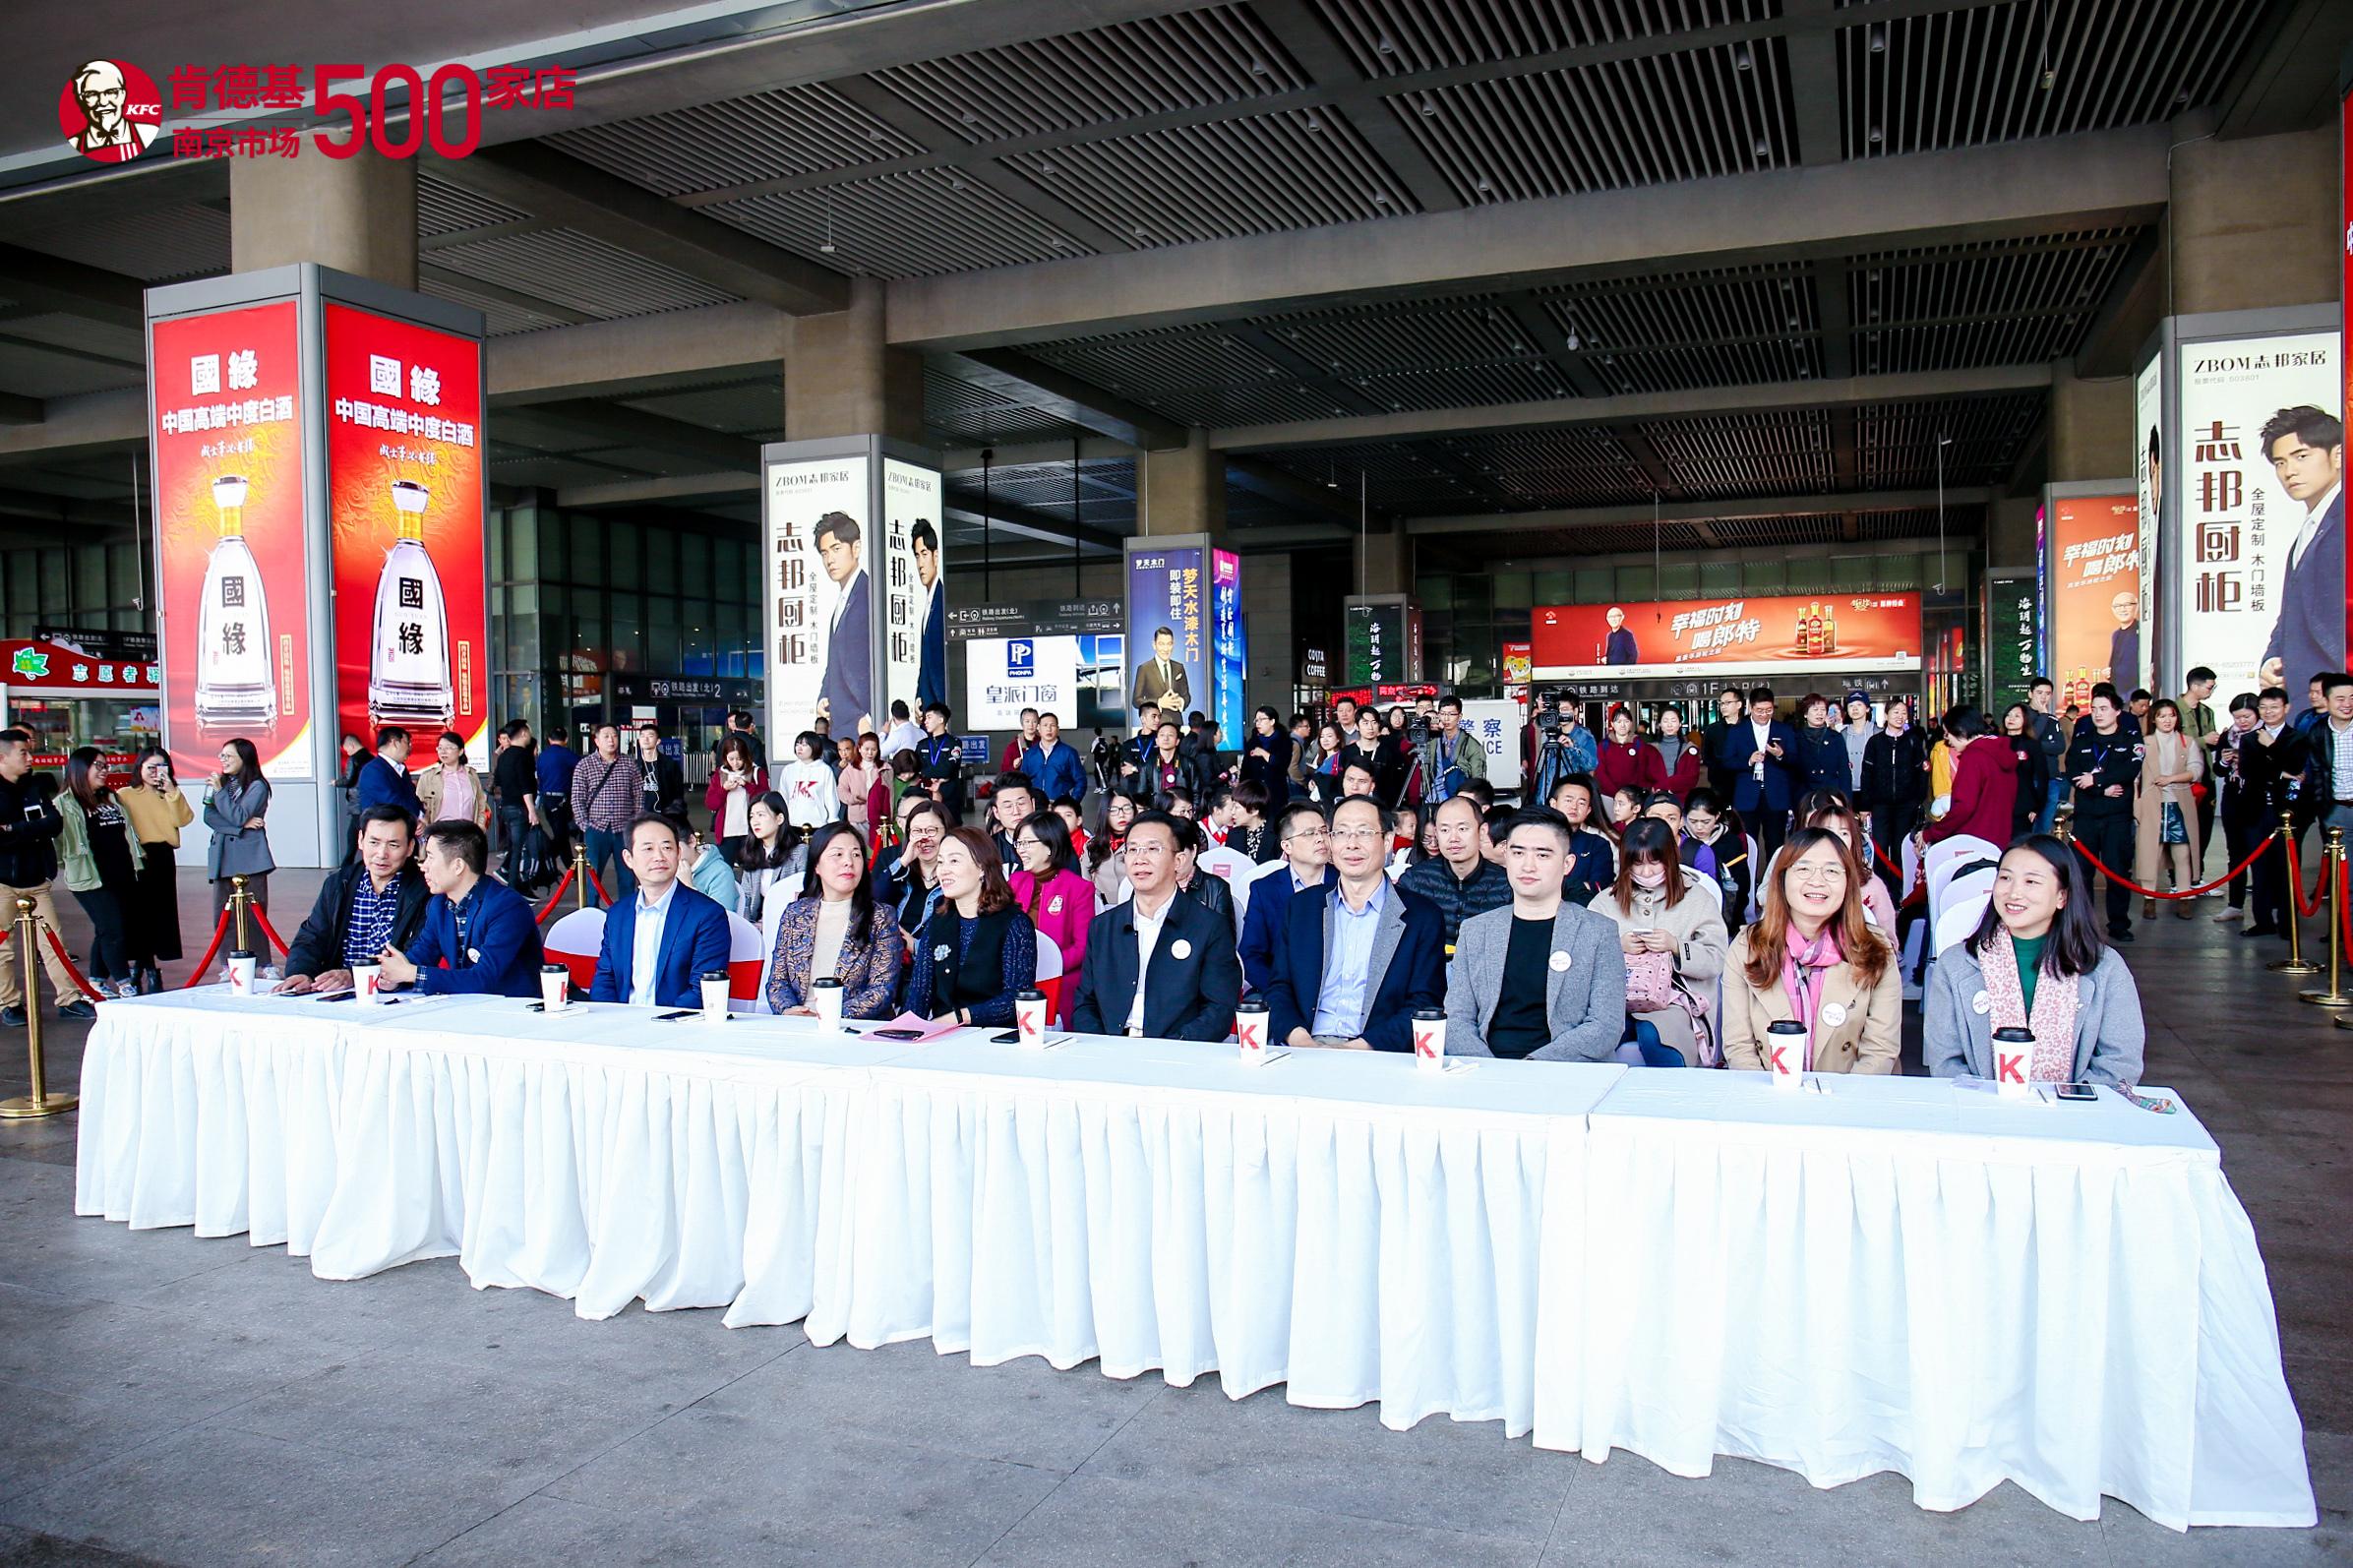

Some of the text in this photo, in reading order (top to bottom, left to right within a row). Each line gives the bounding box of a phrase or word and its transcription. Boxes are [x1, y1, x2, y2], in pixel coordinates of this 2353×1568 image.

[161, 394, 293, 436] 中国高端中度白酒
[334, 396, 474, 448] 中国高端中度白酒
[2194, 421, 2244, 613] 志邦厨柜
[2063, 532, 2135, 568] 幸福时刻
[2251, 487, 2266, 613] 全屋定制 木门墙板
[1169, 569, 1182, 621] 即装即住
[1181, 568, 1199, 662] 梦天水漆木门
[1670, 601, 1744, 639] 幸福时刻
[1690, 618, 1761, 650] 喝郎特
[1306, 664, 1326, 678] COFFEE
[1307, 648, 1325, 662] COSTA
[985, 684, 1058, 704] 皇派门窗
[1579, 685, 1619, 694] 铁路到达
[1841, 678, 1863, 688] 地铁
[1016, 1010, 1037, 1036] K
[1238, 1023, 1260, 1050] K
[1415, 1031, 1437, 1059] K
[1771, 1046, 1790, 1075] K
[1999, 1053, 2026, 1085] K
